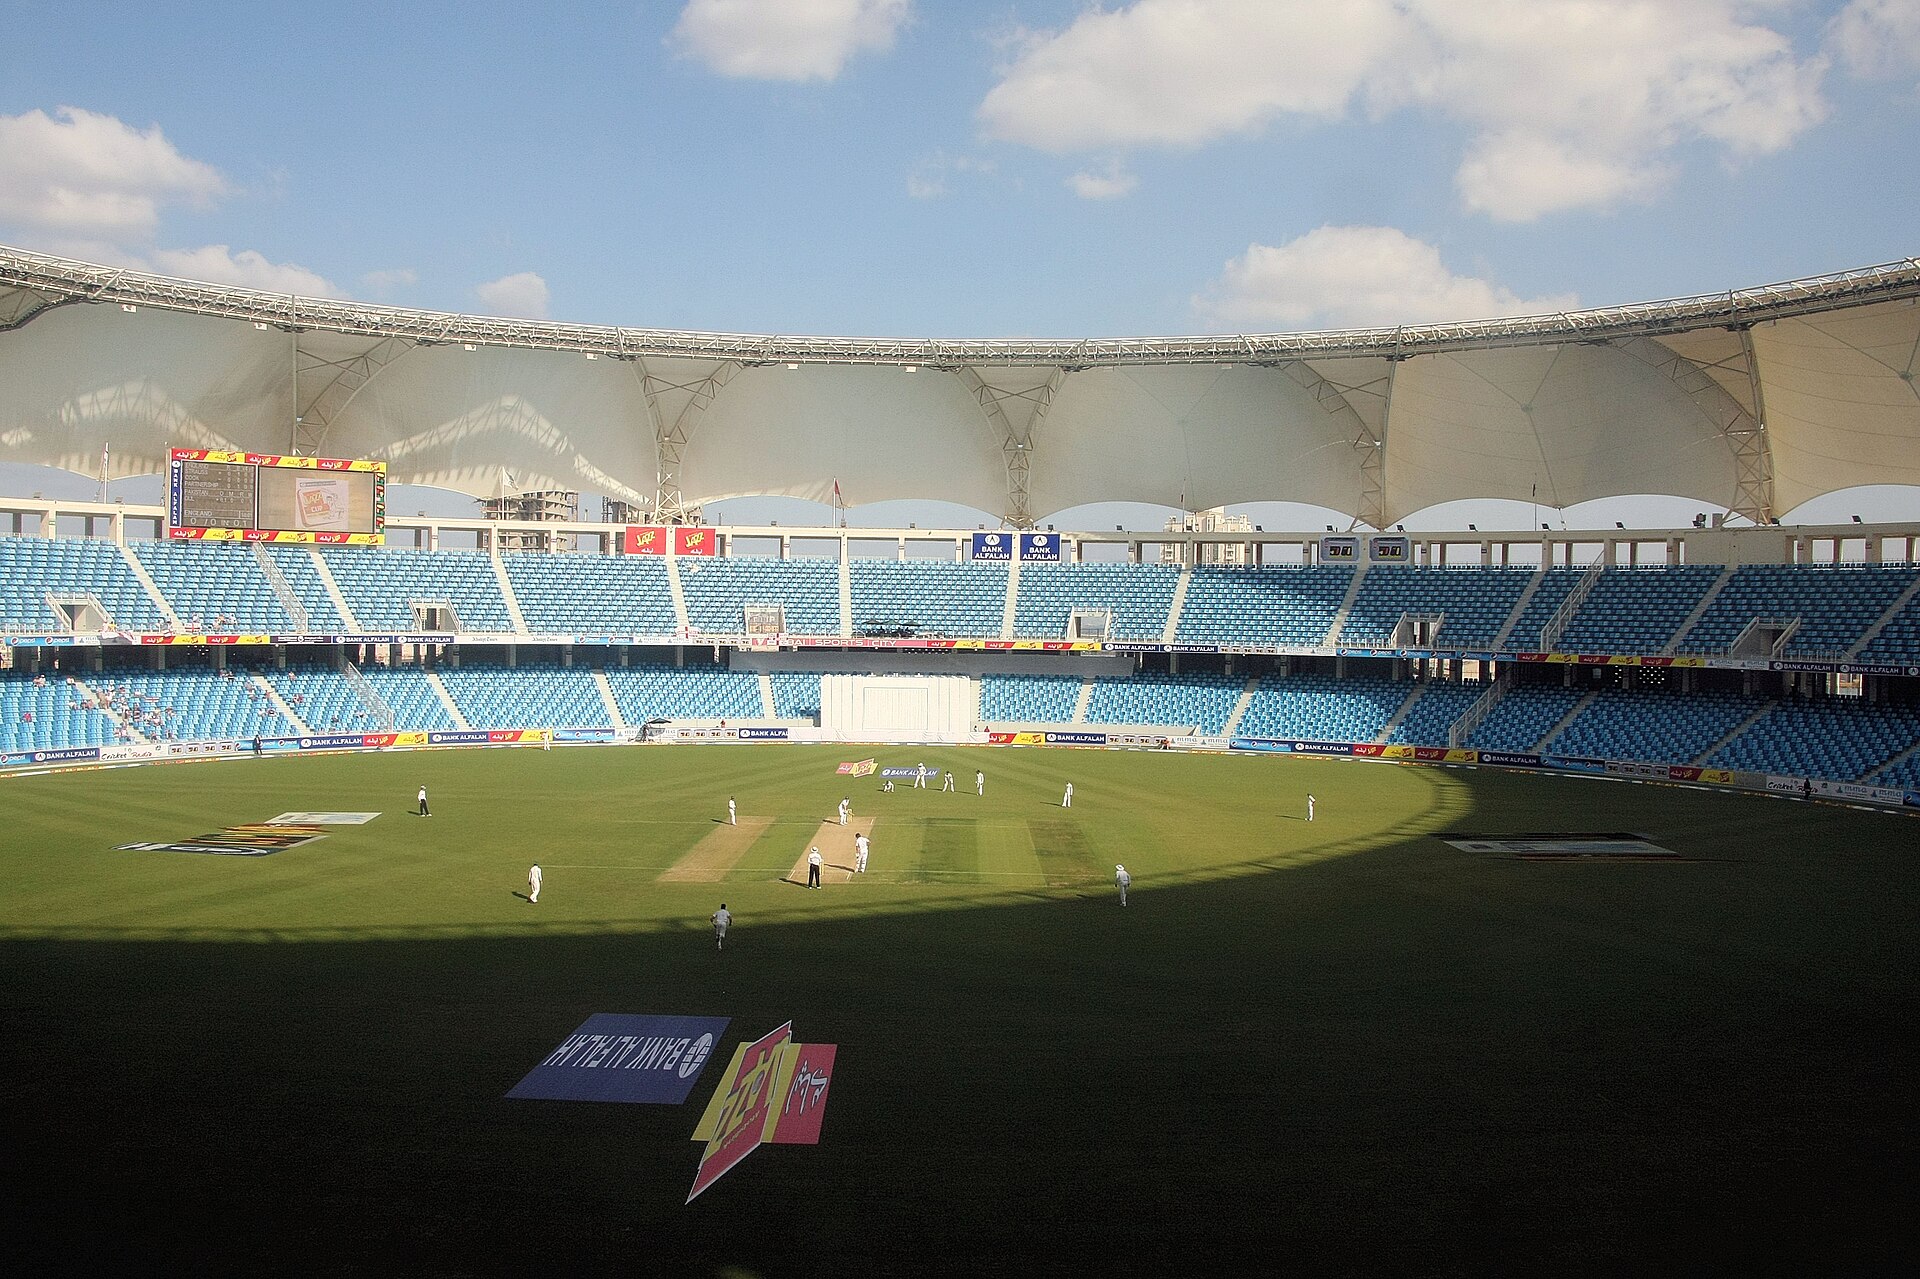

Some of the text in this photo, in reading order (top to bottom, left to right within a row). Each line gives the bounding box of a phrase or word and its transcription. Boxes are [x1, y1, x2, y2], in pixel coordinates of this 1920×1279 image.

[184, 510, 212, 518] ENGLAND
[1802, 664, 1830, 672] ALFALAH
[1870, 666, 1899, 674] ALFALAH
[64, 750, 96, 758] ALFALAH
[102, 752, 126, 760] Cricket
[1492, 755, 1537, 765] BANK ALFALAH
[1768, 782, 1793, 790] Cricket
[542, 1034, 691, 1070] BANK ALFALAH
